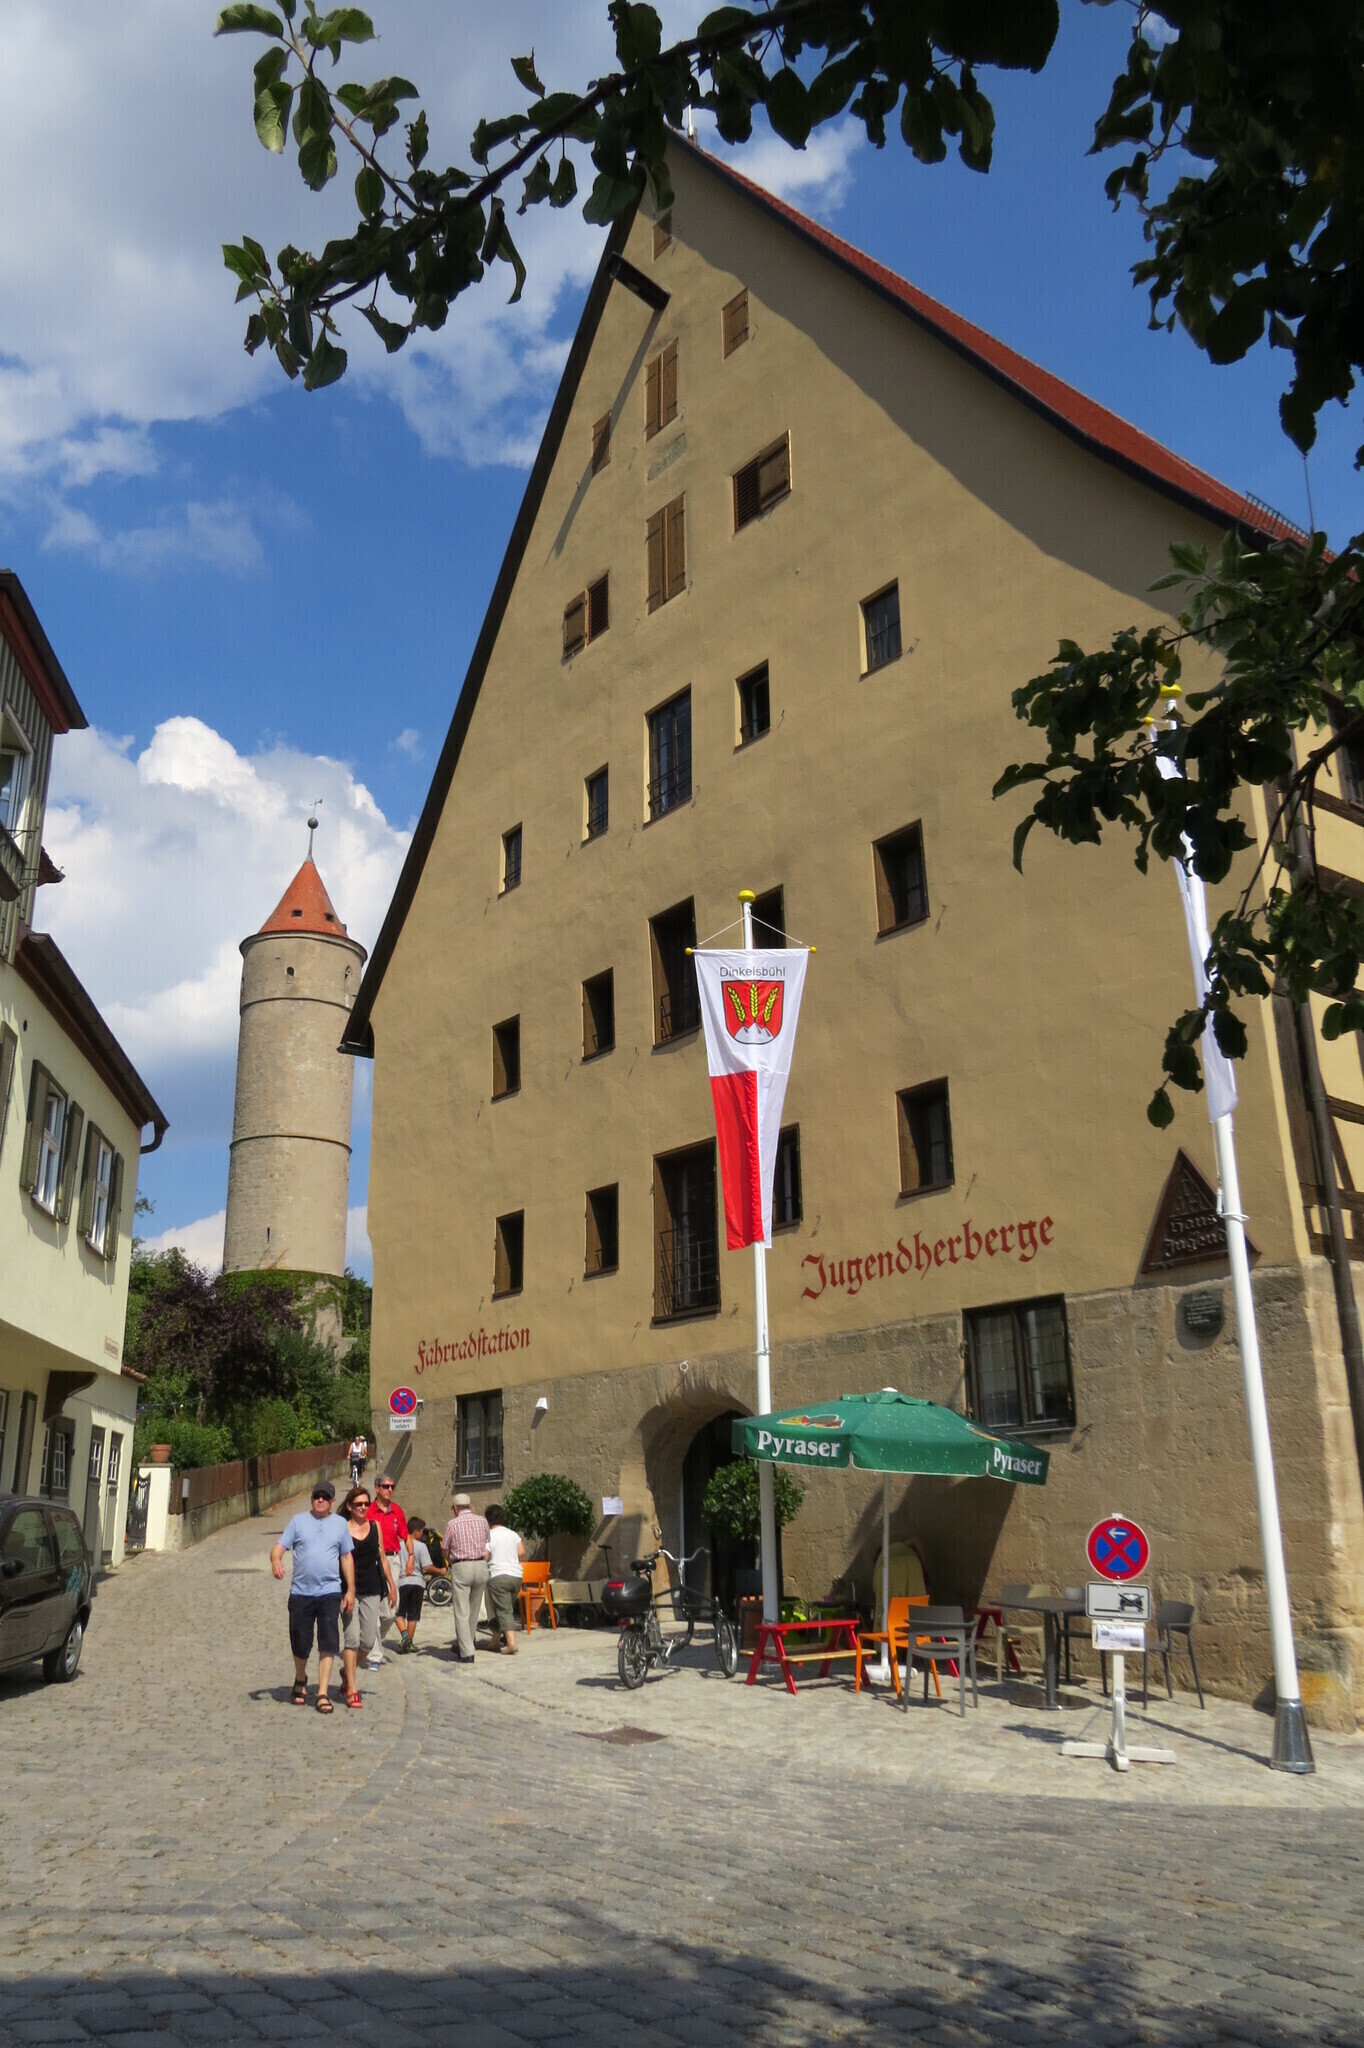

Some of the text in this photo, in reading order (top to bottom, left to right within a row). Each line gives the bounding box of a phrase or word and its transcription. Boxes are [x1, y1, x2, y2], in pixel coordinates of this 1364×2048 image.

[719, 966, 786, 977] Dinkelsbühl
[801, 1215, 1055, 1300] Jugendherberge
[757, 1430, 841, 1458] Pyraser
[993, 1446, 1043, 1476] Pyraser
